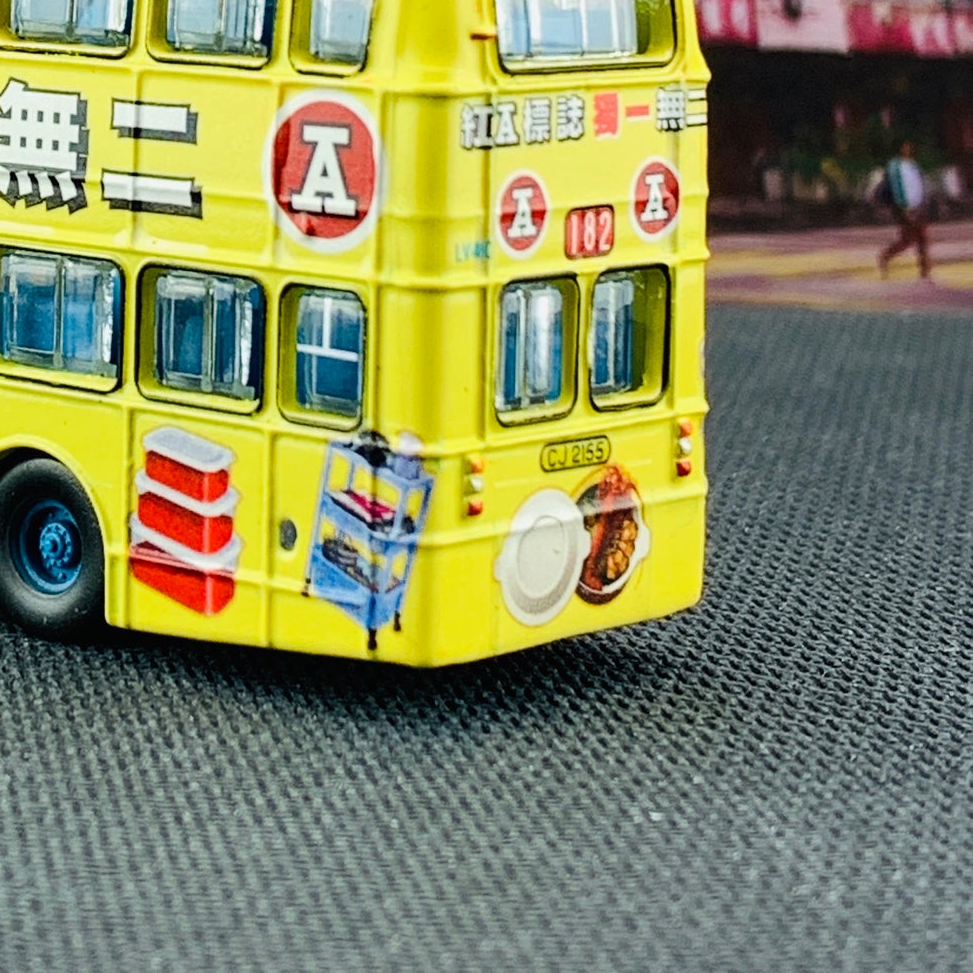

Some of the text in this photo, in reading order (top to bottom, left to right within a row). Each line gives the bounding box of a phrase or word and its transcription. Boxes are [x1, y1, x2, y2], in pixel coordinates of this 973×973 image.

[289, 122, 358, 217] A
[507, 187, 538, 239] A
[640, 173, 669, 222] A
[569, 209, 611, 256] 182
[547, 445, 568, 467] CJ
